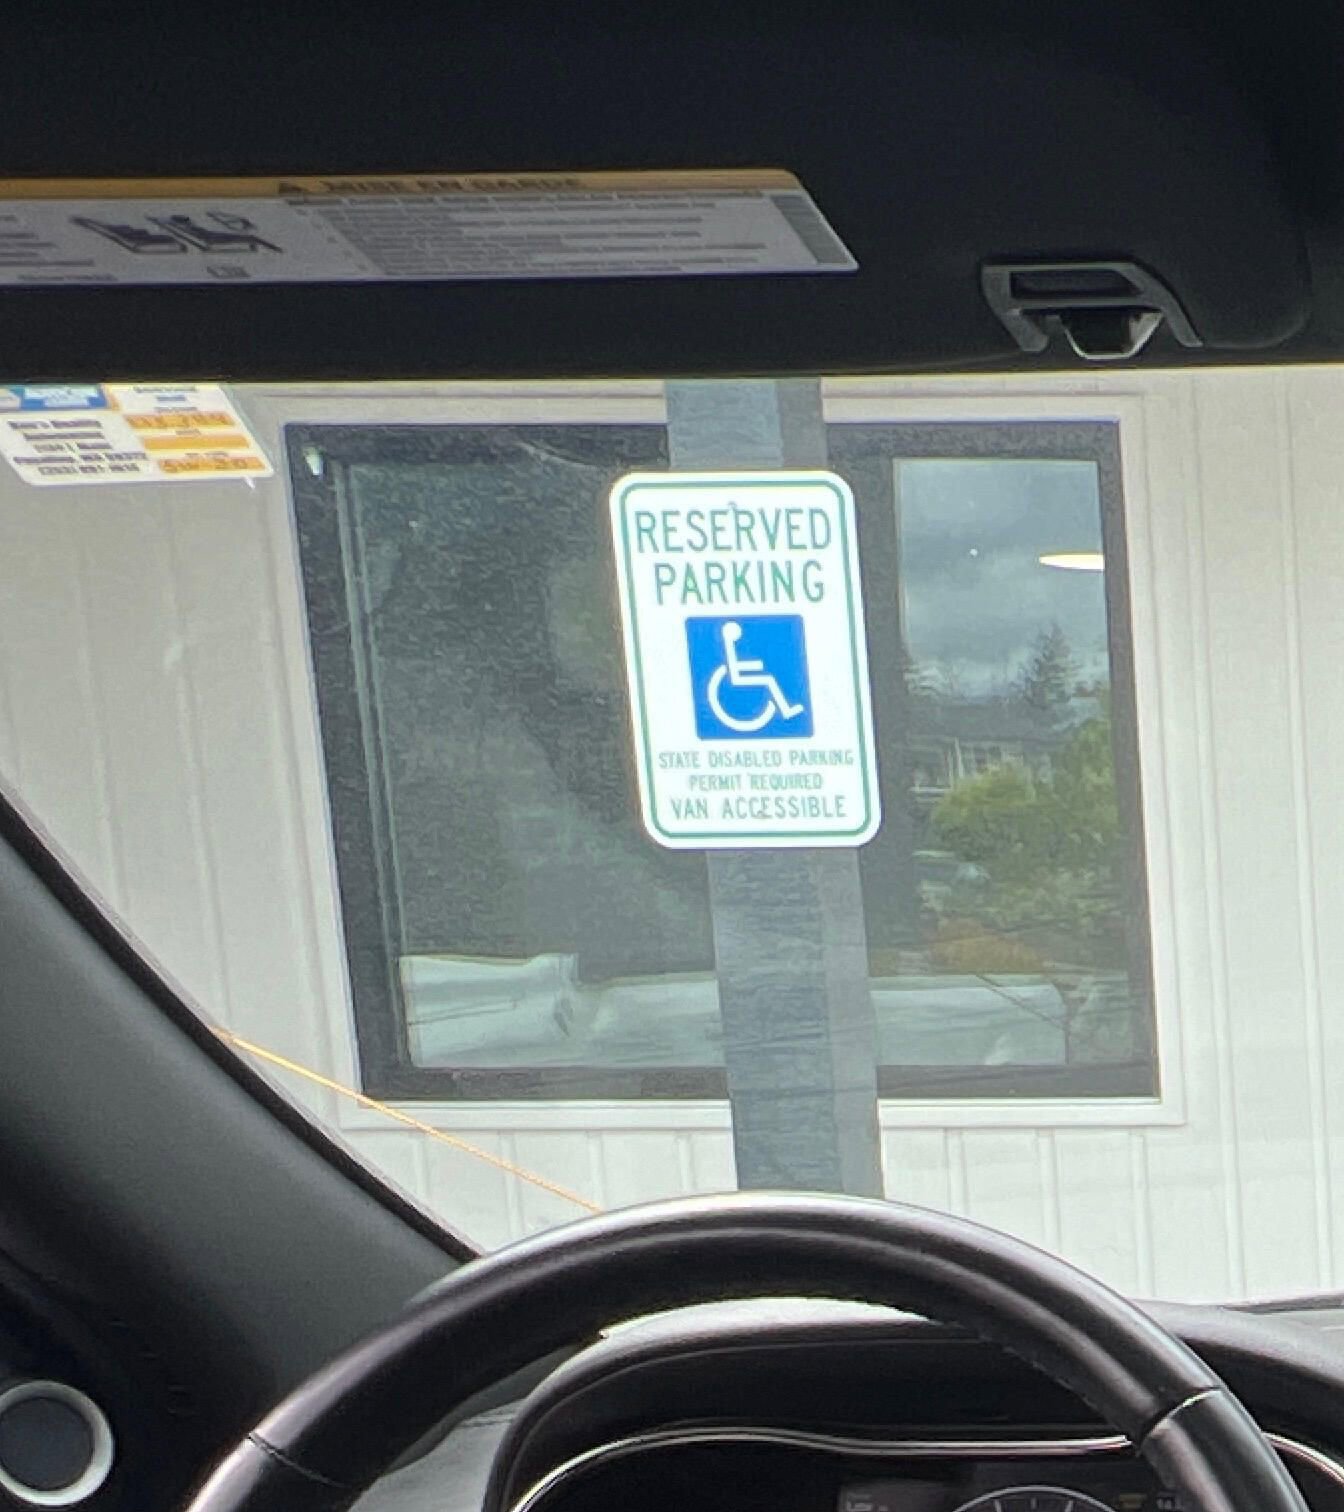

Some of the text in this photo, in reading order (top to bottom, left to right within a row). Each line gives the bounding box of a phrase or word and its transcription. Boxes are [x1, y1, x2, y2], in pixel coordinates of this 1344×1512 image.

[634, 507, 832, 553] RESERVED
[653, 559, 826, 605] PARKING
[658, 748, 855, 769] STATE DISABLED PARKING
[688, 772, 824, 791] PERMIT REQUIRED
[670, 795, 848, 820] VAN ACCESSIBLE
